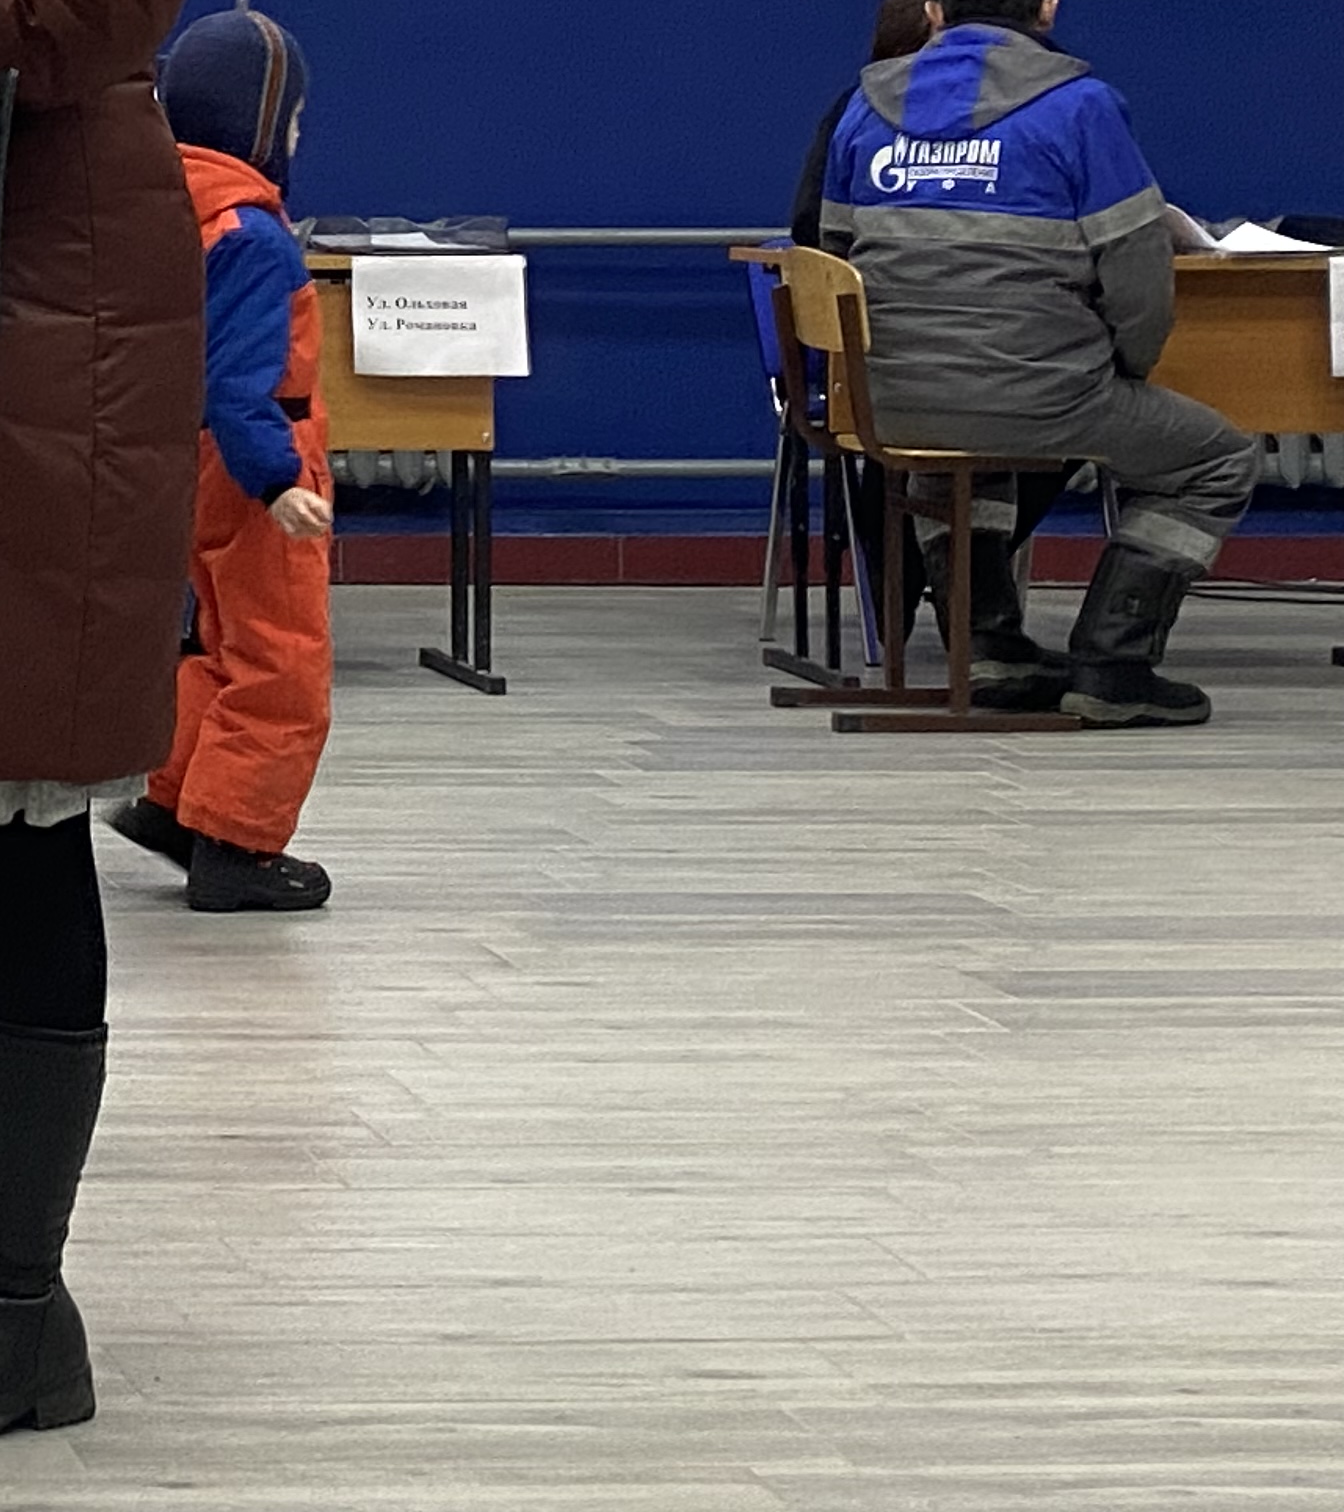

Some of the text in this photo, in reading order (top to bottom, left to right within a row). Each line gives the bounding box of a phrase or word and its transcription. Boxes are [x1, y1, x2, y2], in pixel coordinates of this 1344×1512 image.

[908, 139, 1002, 165] ГАЗПРОМ
[367, 296, 468, 310] Ул. Ольховая
[367, 317, 392, 331] Ул.
